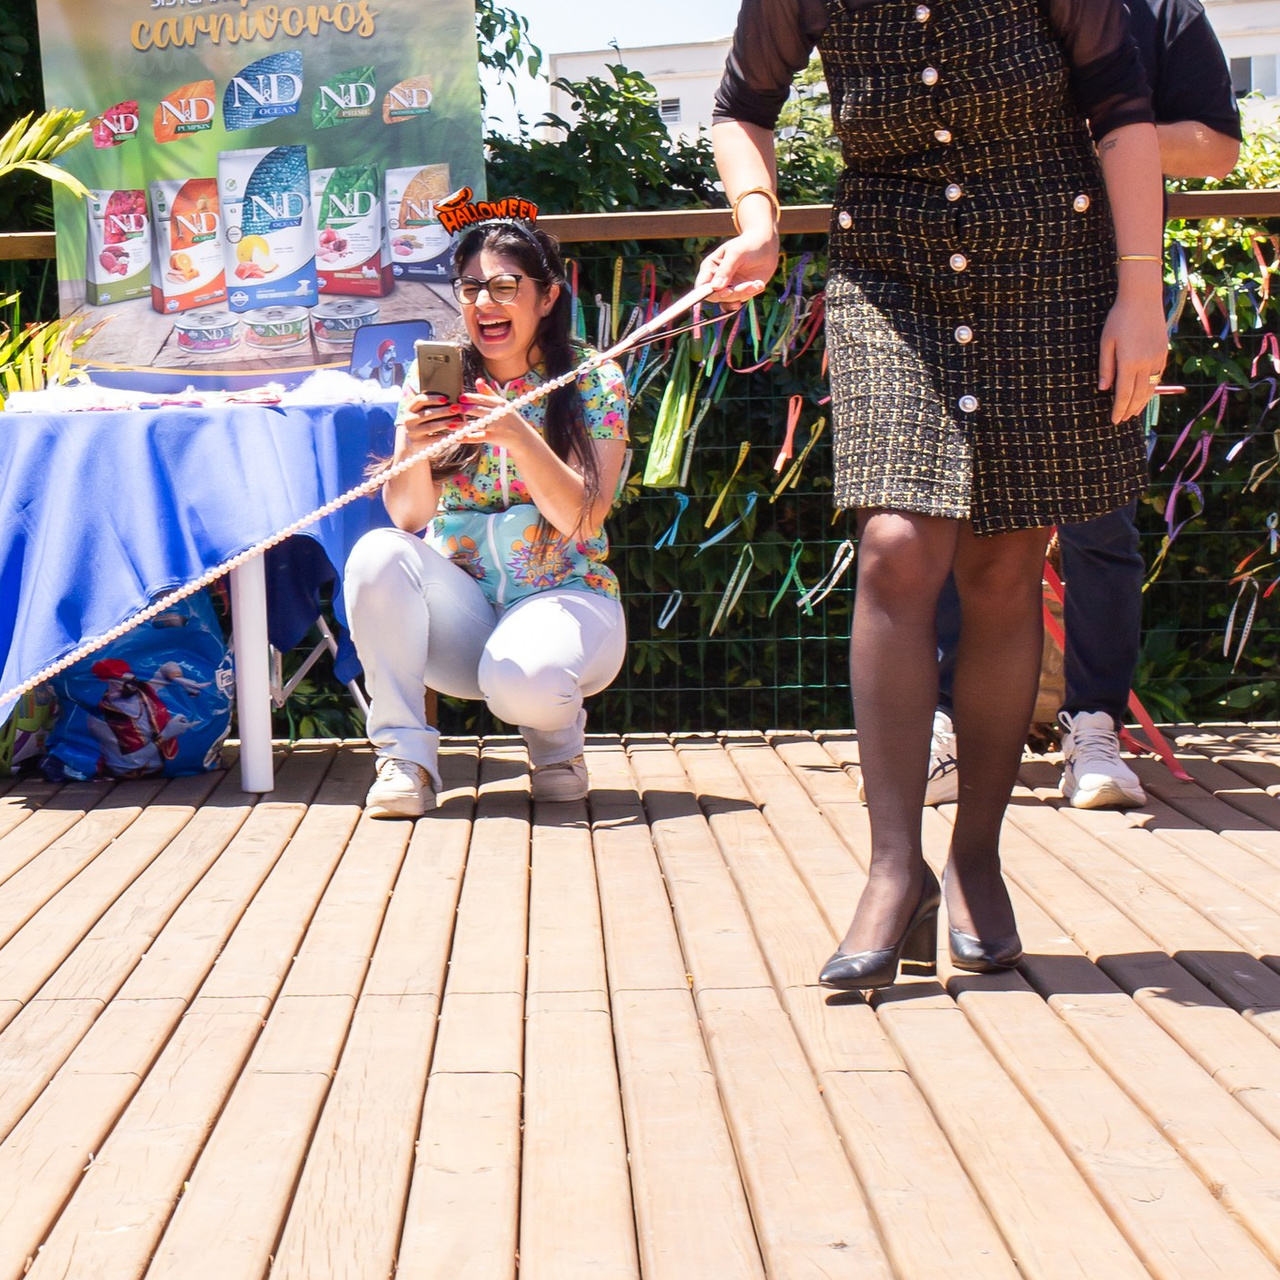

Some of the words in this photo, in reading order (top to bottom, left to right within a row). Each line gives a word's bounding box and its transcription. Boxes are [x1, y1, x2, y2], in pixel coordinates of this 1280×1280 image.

[231, 73, 303, 107] N&D
[319, 82, 376, 110] N&D
[388, 87, 433, 109] N&D
[160, 97, 215, 125] N&D
[258, 106, 297, 115] OCEAN
[250, 191, 306, 221] N&D
[328, 191, 377, 218] N&D
[438, 197, 538, 237] HALLOWEEN
[272, 220, 300, 228] OCEAN
